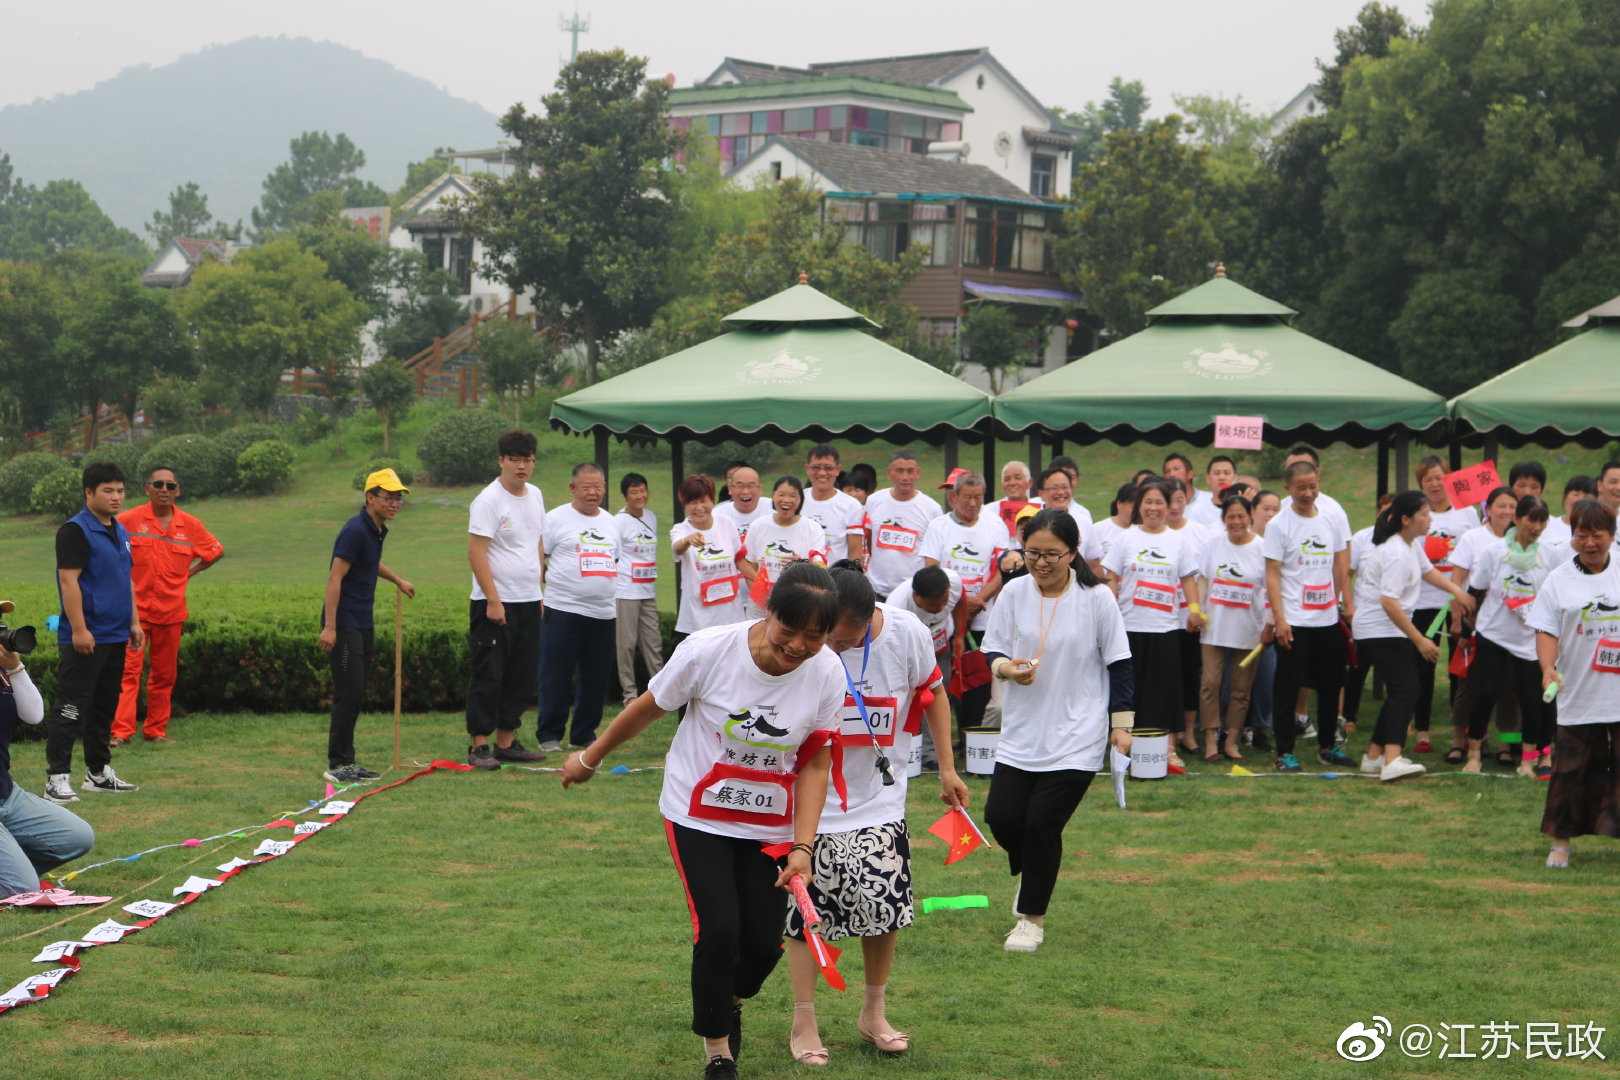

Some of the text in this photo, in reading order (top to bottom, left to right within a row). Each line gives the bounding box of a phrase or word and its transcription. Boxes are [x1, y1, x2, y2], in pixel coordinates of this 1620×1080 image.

[1218, 424, 1260, 440] 候场区
[582, 558, 604, 569] 中一
[869, 711, 890, 729] 01
[716, 786, 774, 808] 蔡家 01
